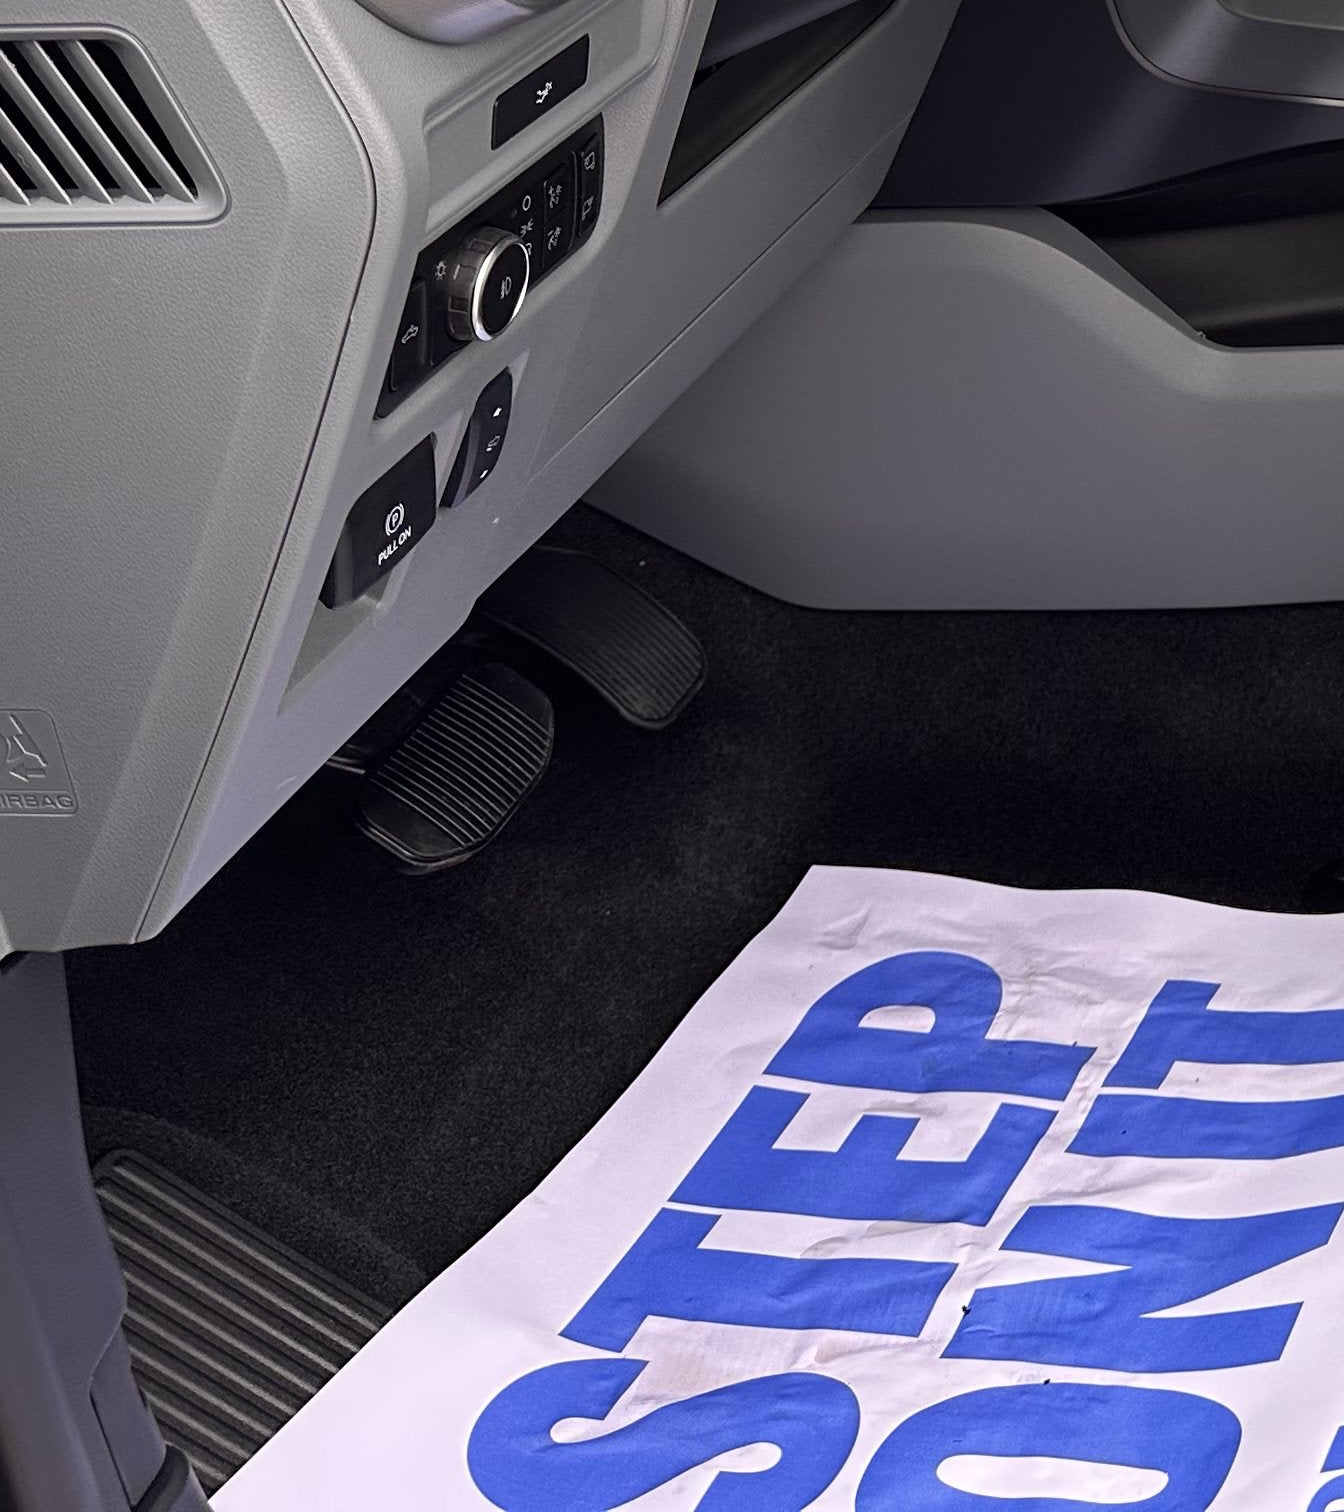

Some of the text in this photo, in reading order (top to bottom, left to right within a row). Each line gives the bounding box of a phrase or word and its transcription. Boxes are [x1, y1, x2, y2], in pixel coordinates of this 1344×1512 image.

[378, 525, 412, 566] PULL ON
[0, 794, 74, 809] IRBAG
[466, 949, 1099, 1512] STEP
